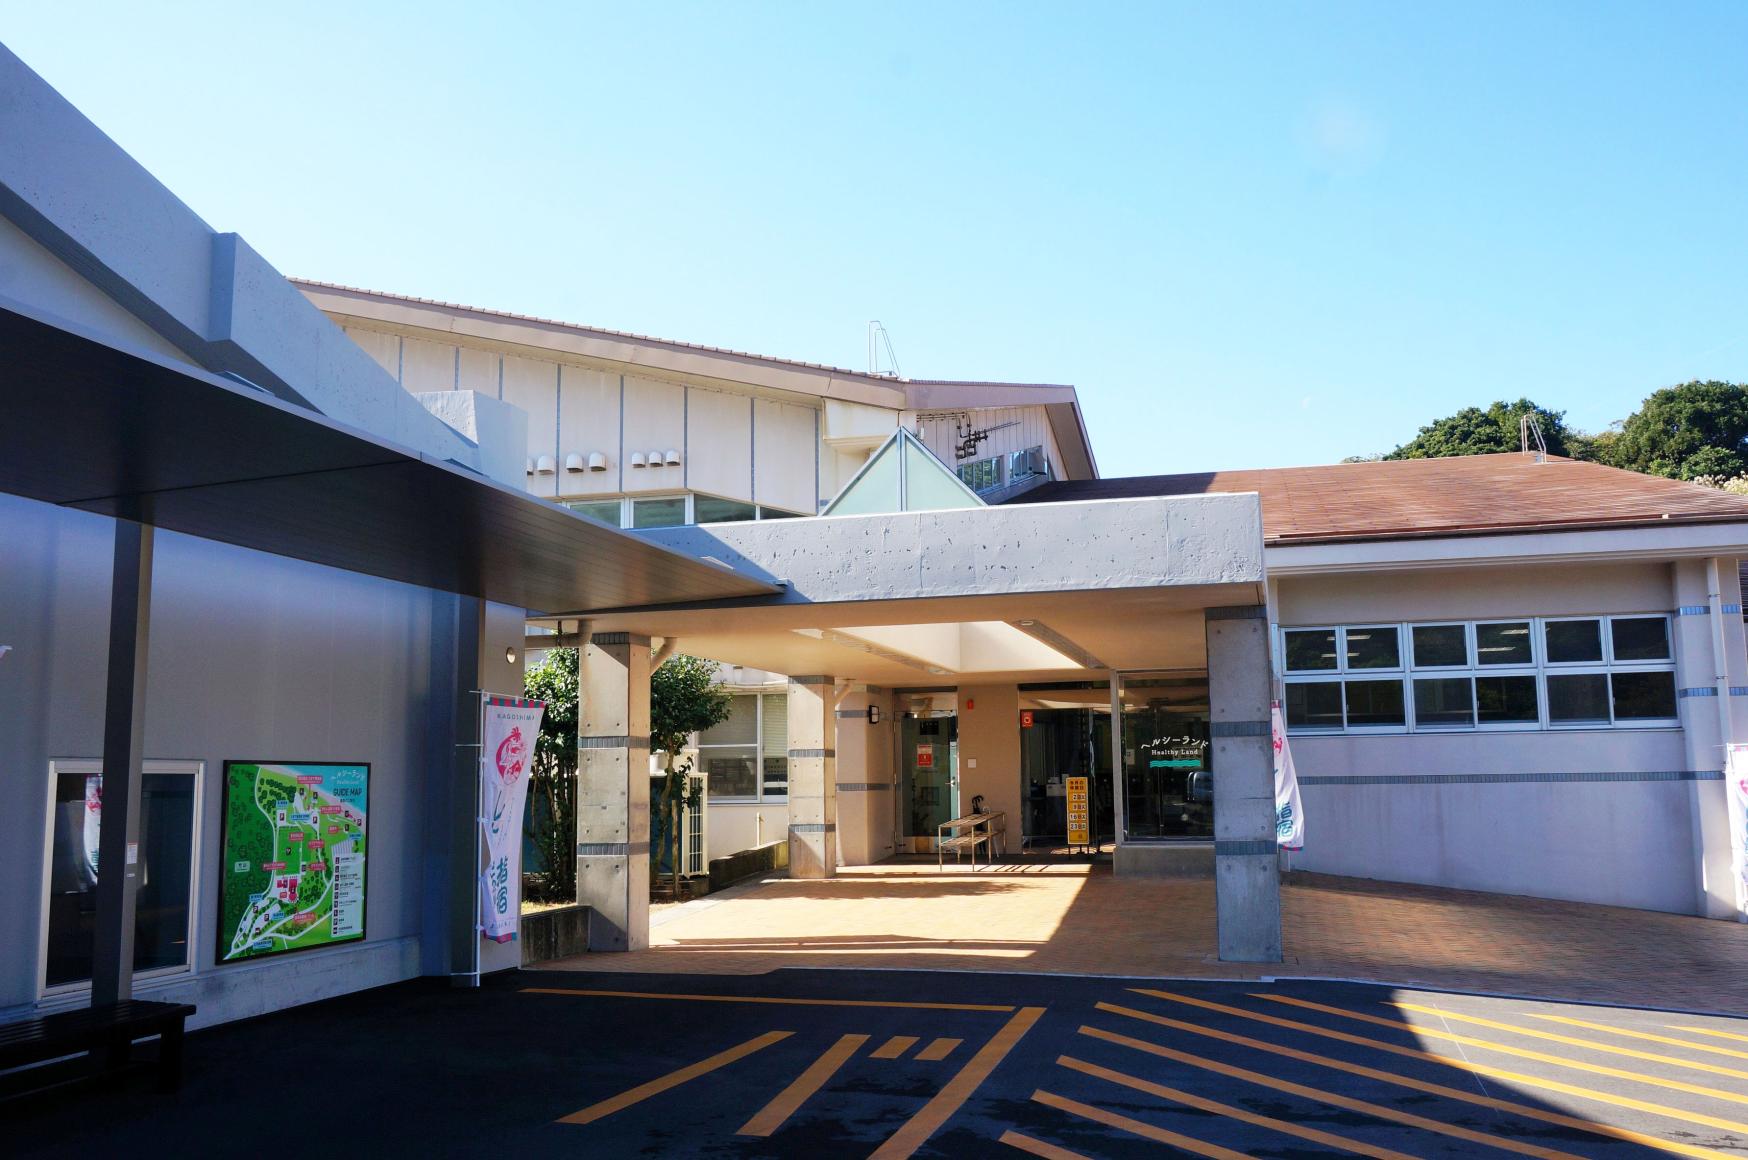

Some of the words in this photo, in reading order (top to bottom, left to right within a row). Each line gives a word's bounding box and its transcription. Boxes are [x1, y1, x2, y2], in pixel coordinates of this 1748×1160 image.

[1140, 735, 1209, 749] ヘルシーランド
[333, 788, 349, 796] GUIDE
[350, 787, 362, 796] MAP
